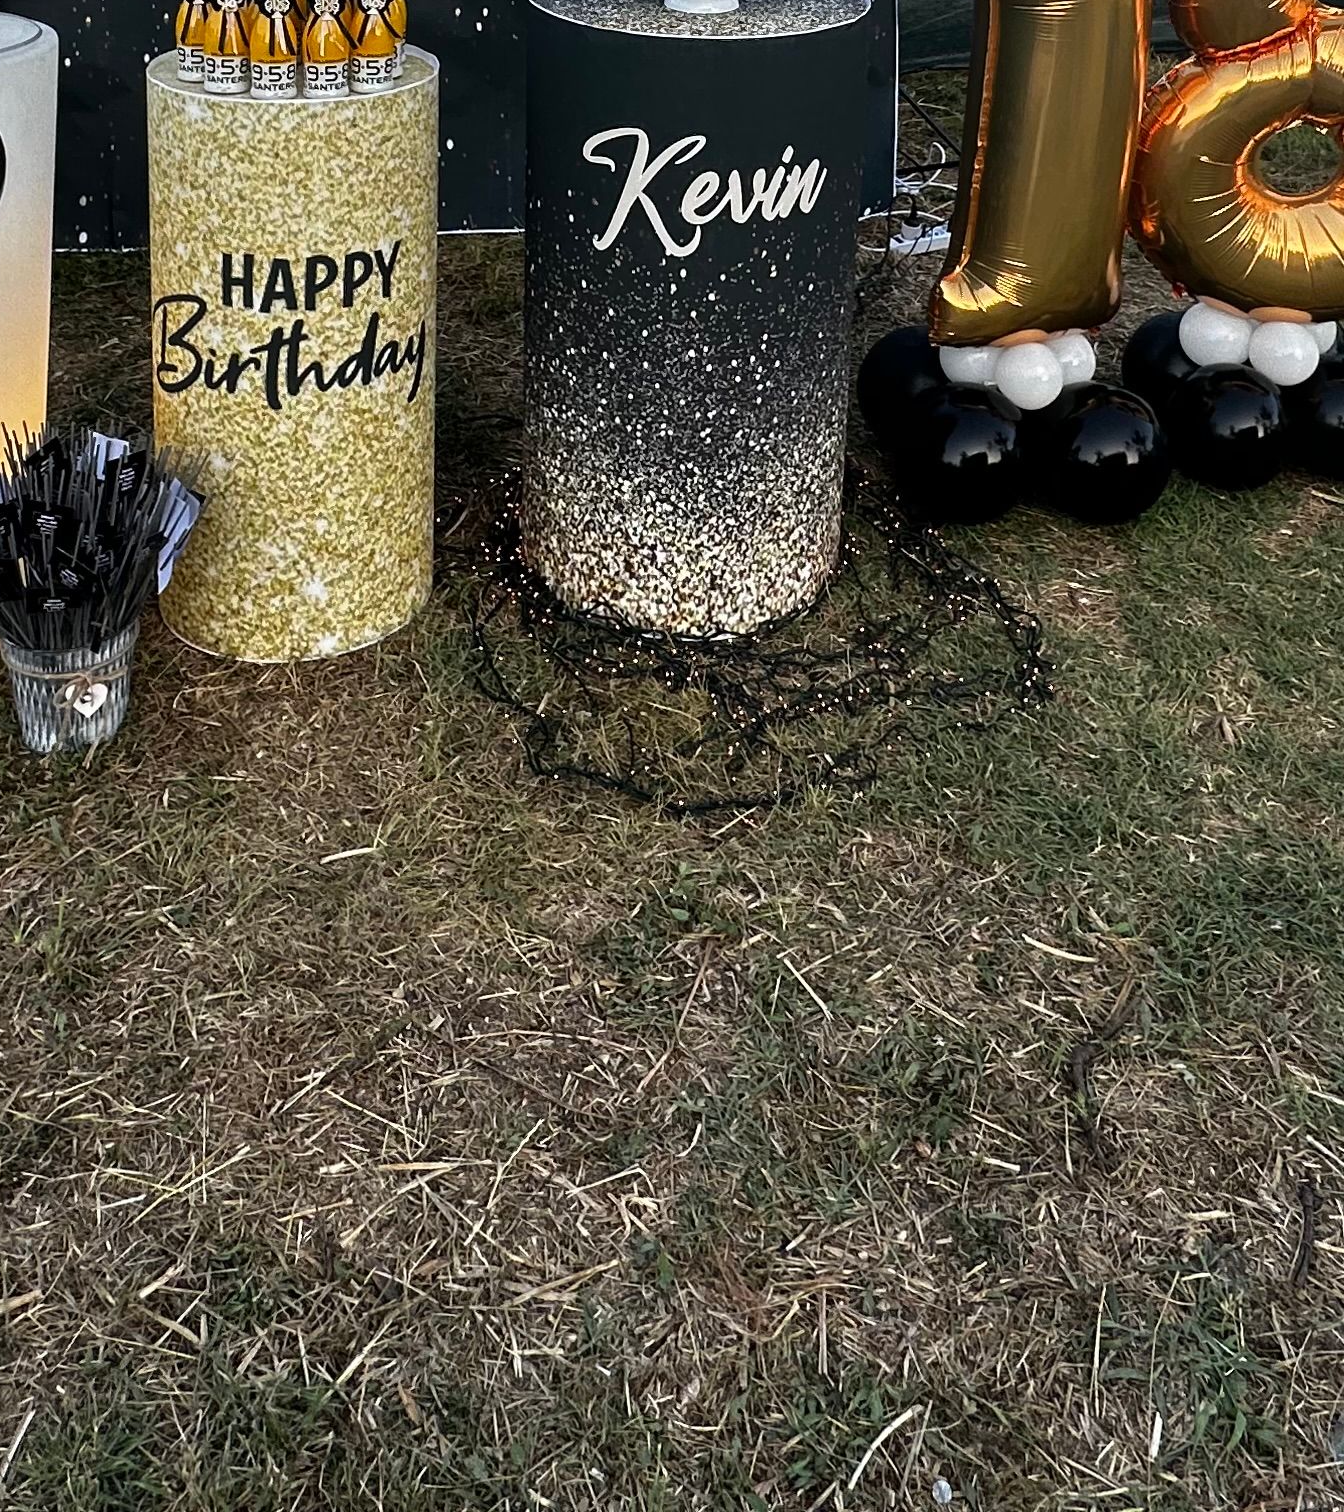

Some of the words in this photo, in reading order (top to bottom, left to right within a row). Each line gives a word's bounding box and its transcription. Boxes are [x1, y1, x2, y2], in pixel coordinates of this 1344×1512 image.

[582, 127, 828, 258] Kevin
[220, 240, 403, 314] HAPPY
[152, 293, 427, 411] Birthday
